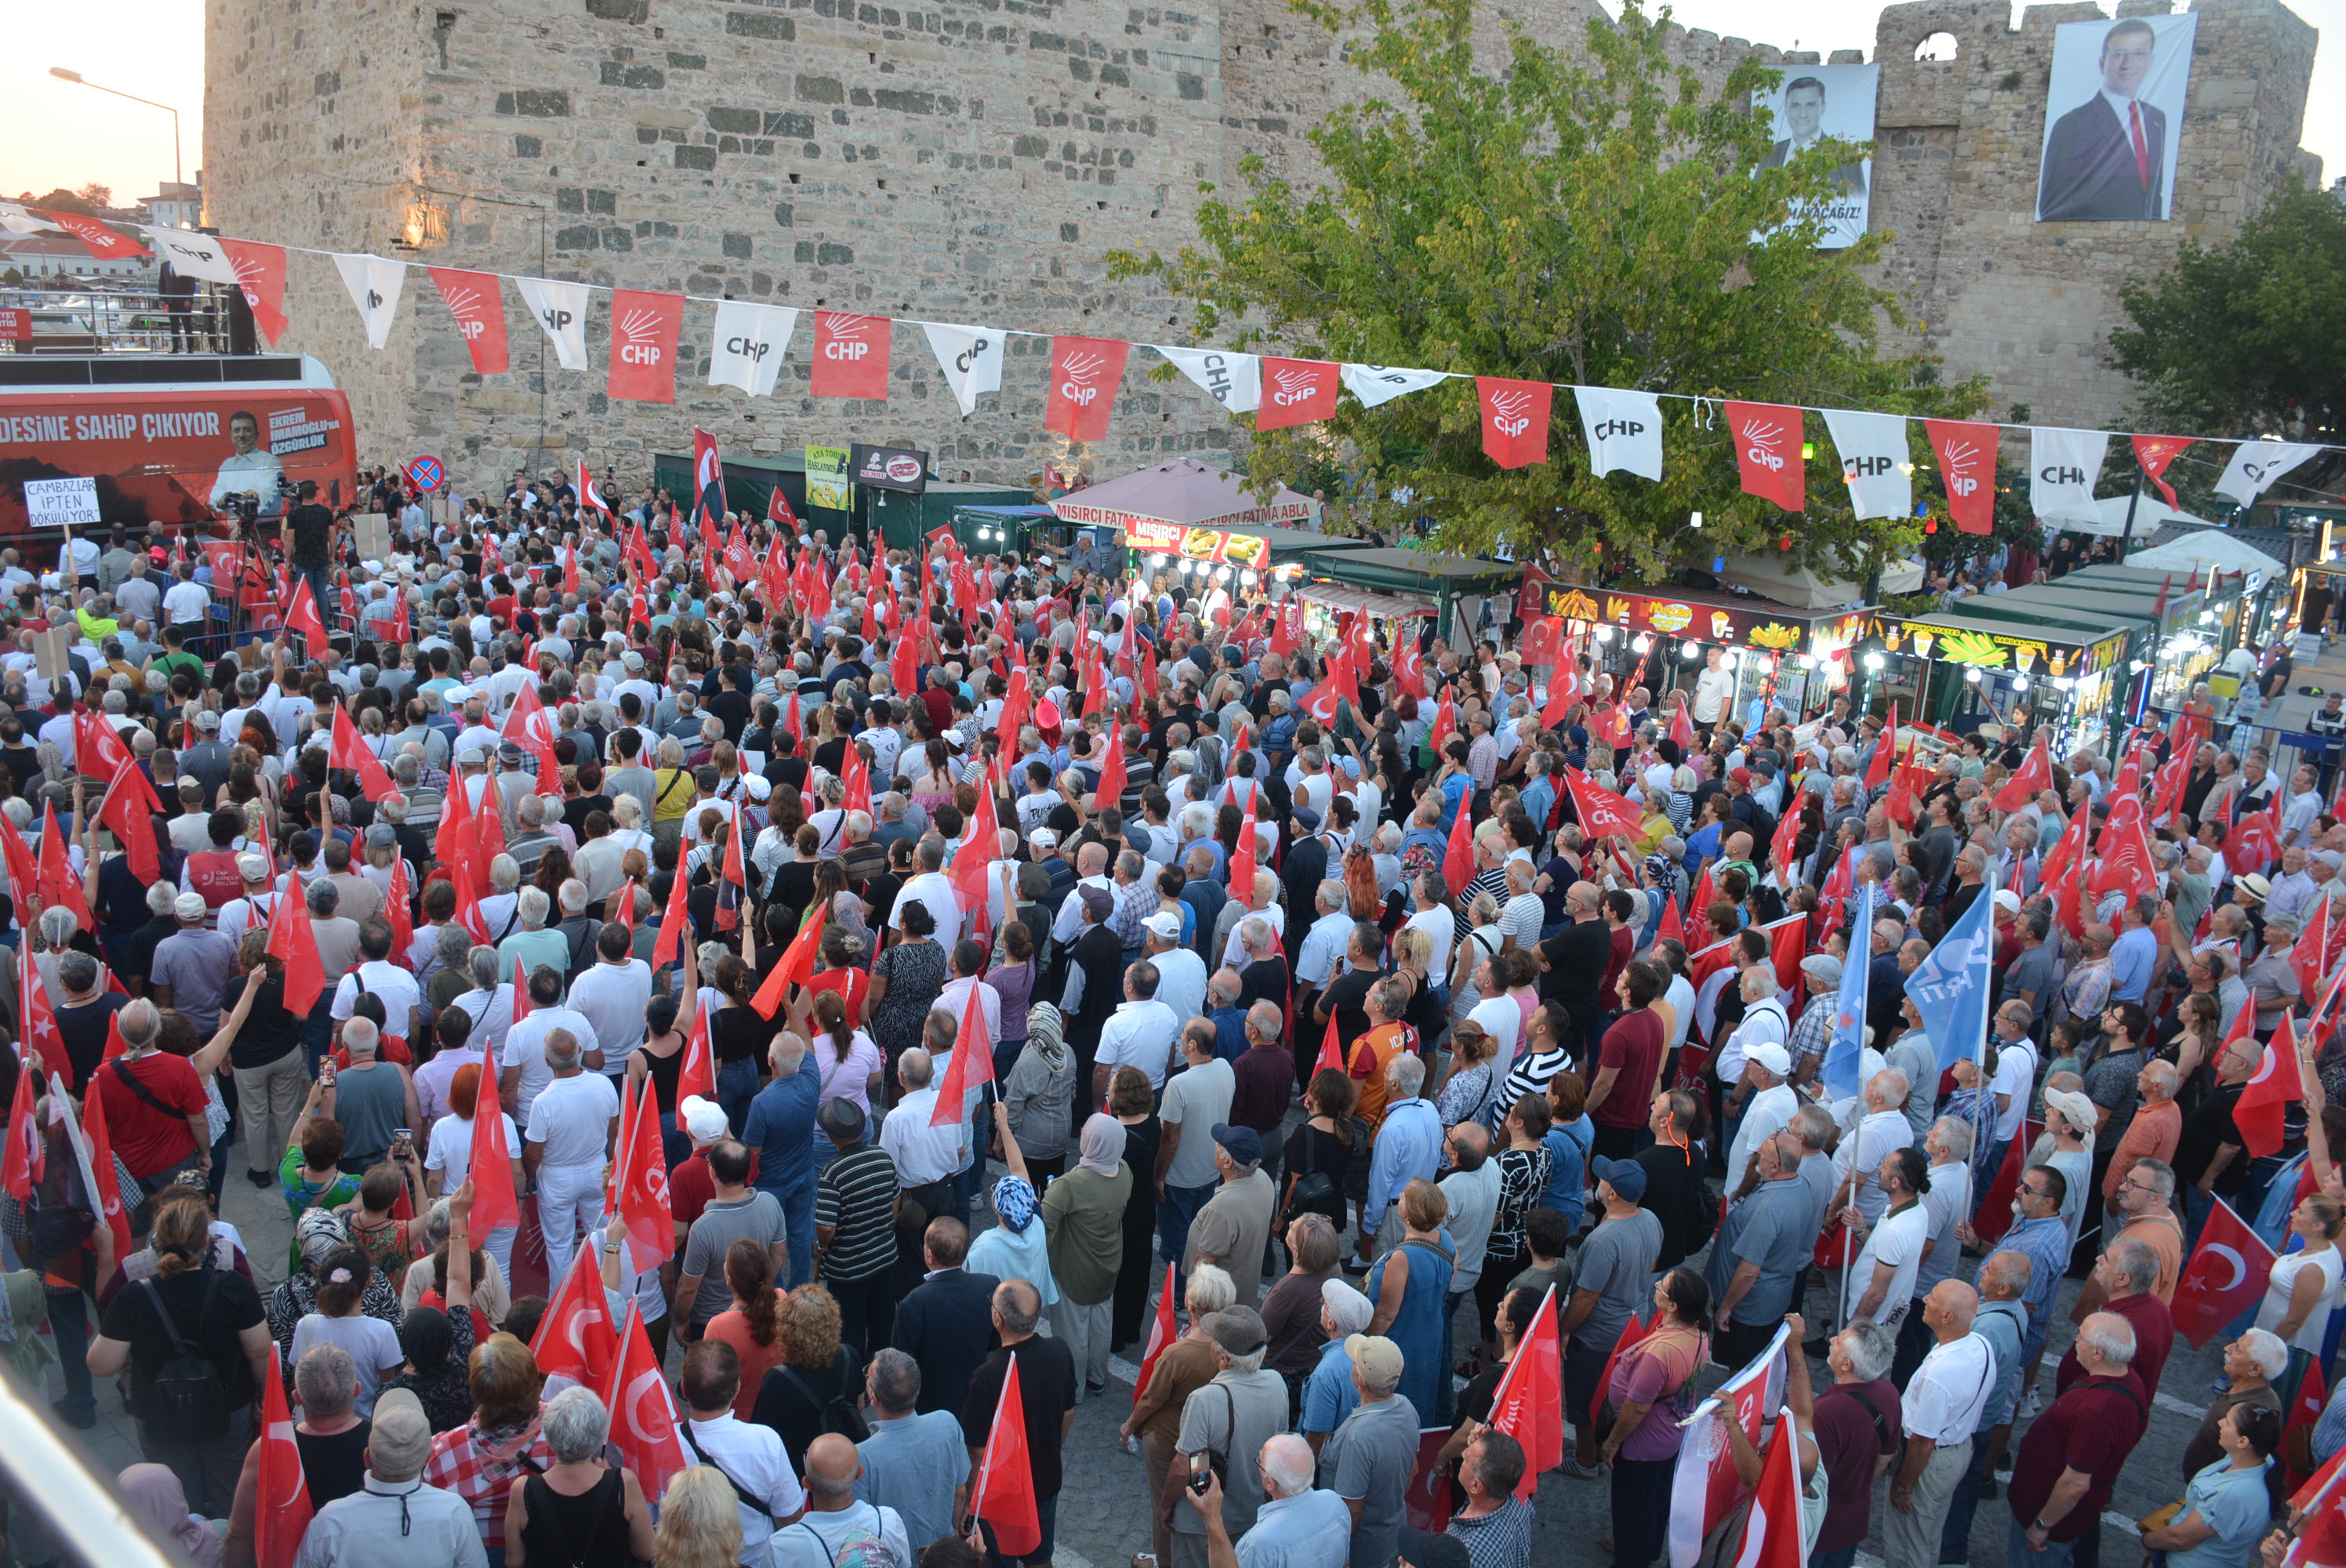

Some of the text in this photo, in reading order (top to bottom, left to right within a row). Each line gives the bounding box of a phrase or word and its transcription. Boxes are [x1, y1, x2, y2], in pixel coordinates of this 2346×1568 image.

[169, 244, 213, 262] CHP
[543, 309, 572, 331] HP
[459, 321, 485, 340] HP
[621, 345, 660, 365] CHP
[726, 336, 769, 363] CHP
[825, 342, 868, 361] CHP
[955, 339, 988, 374] CP
[1204, 354, 1232, 403] CHP
[1062, 382, 1096, 406] CHP
[1273, 387, 1316, 406] CHP
[75, 414, 137, 441] SAHİP
[142, 412, 220, 442] ÇIKIYOR
[269, 412, 306, 429] EKREM
[1494, 416, 1530, 437] CHP
[1594, 419, 1644, 441] CHP
[271, 434, 325, 455] ÖZGÜRLÜK
[812, 450, 824, 460] ATA
[1748, 448, 1784, 472] CHP
[860, 470, 887, 480] KUMRU
[1843, 456, 1893, 477] CHP
[1950, 472, 1977, 496] CHP
[41, 495, 82, 510] İPTEN
[1056, 503, 1102, 523] MISIRCI
[1242, 506, 1279, 523] FATMA
[1281, 503, 1309, 519] ABLA
[725, 545, 741, 562] CHP
[1927, 626, 1961, 636] PATATES
[1994, 636, 2025, 646] BARDAK
[1777, 677, 1791, 691] SU
[1591, 809, 1622, 825] CH
